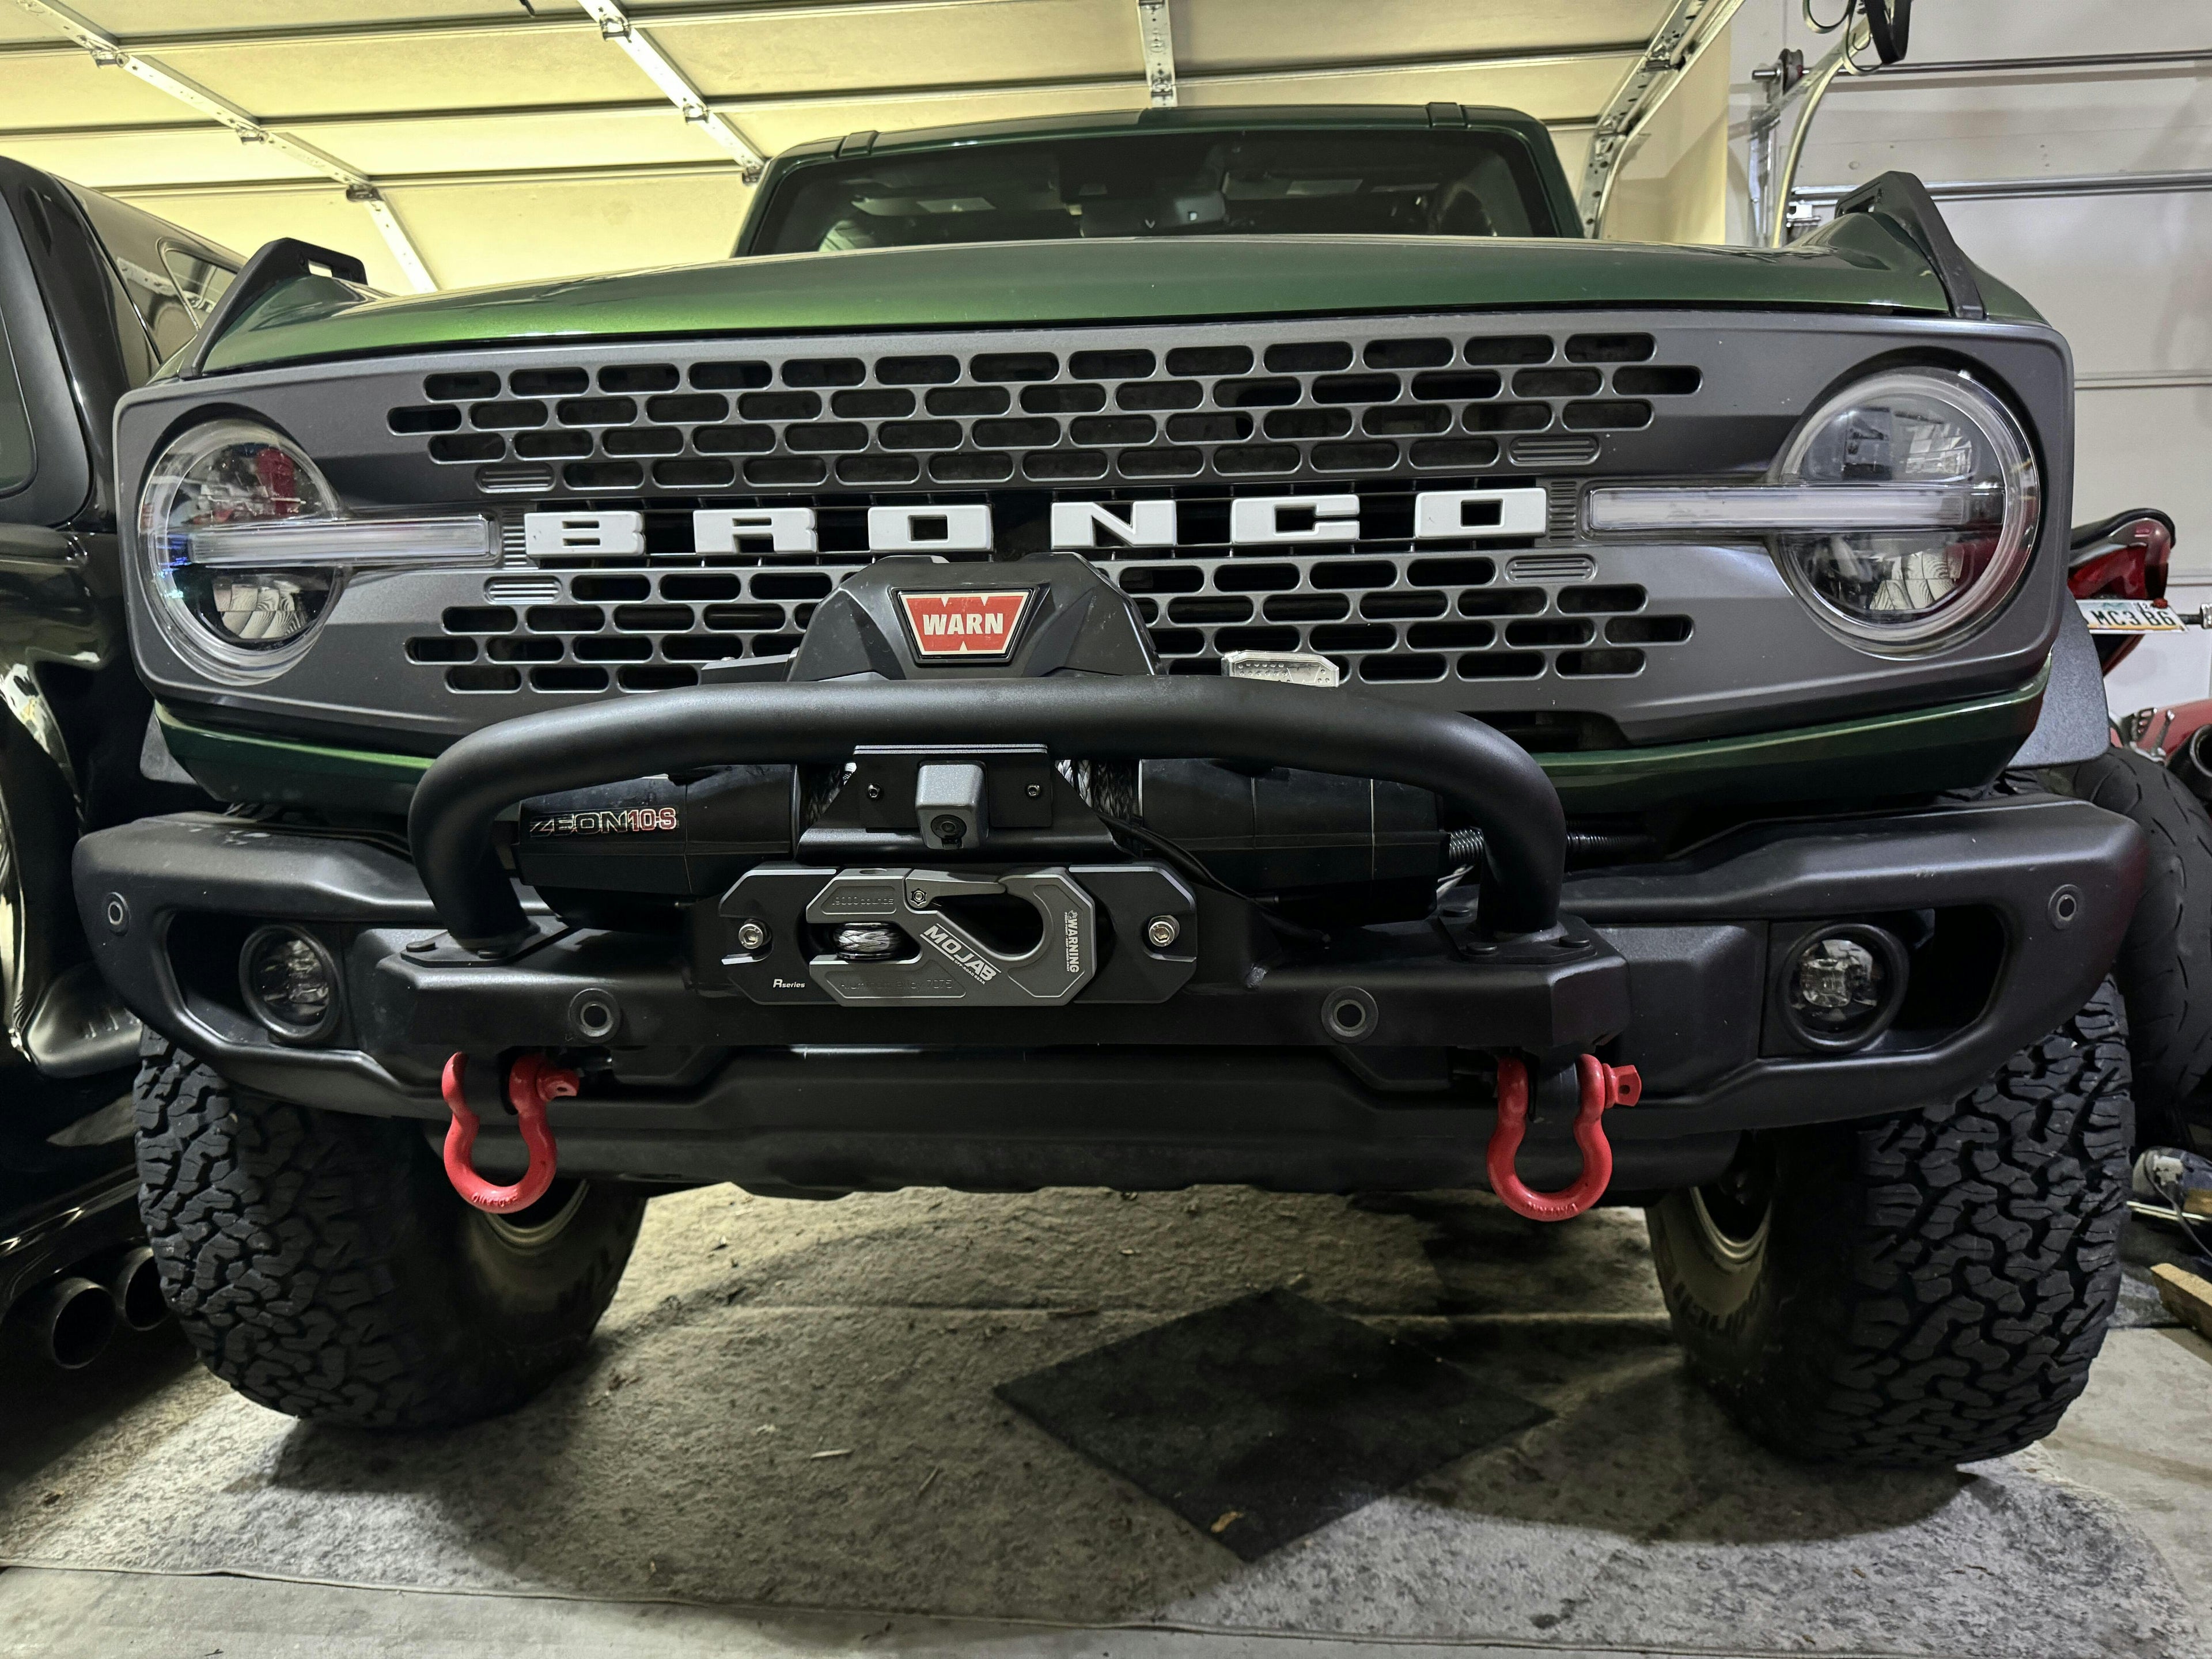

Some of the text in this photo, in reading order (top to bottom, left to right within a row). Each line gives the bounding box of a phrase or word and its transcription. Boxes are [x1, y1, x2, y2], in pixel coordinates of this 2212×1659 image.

[525, 487, 1548, 560] BRONCO
[923, 612, 1003, 635] WARN
[923, 925, 997, 981] MOJAB
[1068, 918, 1080, 972] WARNING
[974, 974, 986, 985] GEAR
